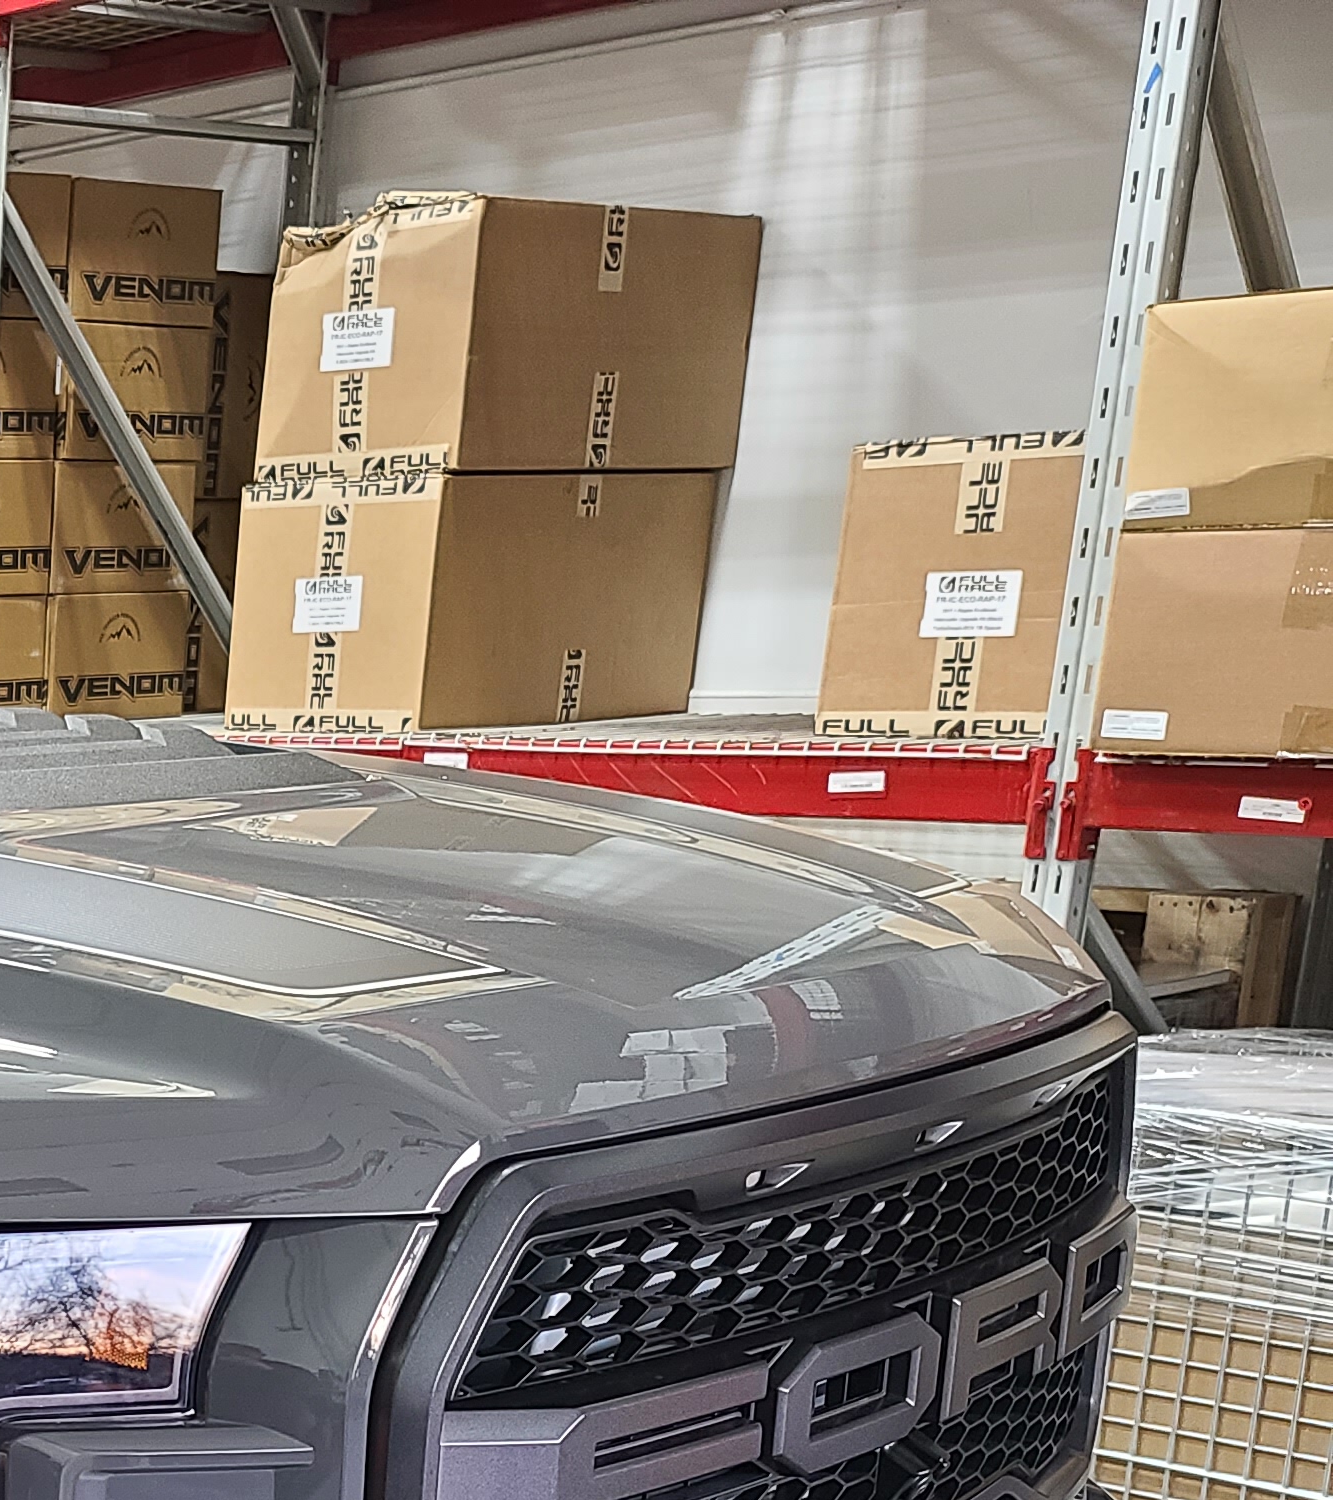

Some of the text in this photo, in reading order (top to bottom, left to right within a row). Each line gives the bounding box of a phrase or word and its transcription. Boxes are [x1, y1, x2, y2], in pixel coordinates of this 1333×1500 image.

[83, 271, 216, 308] VENOM
[348, 257, 363, 312] RAC
[361, 255, 376, 311] FUL
[347, 312, 383, 322] FULL
[280, 460, 345, 476] FULL
[390, 452, 449, 469] FUL
[963, 462, 985, 534] ULL
[980, 461, 1003, 533] ACE
[64, 546, 171, 578] VENO
[958, 583, 1007, 593] RACE
[959, 575, 1008, 584] FULL
[938, 636, 959, 711] FUL
[953, 636, 976, 711] RAC
[57, 673, 184, 706] VENOM
[231, 713, 276, 728] ULL
[319, 715, 384, 730] FULL
[821, 718, 910, 735] FULL
[971, 718, 1046, 735] FUL
